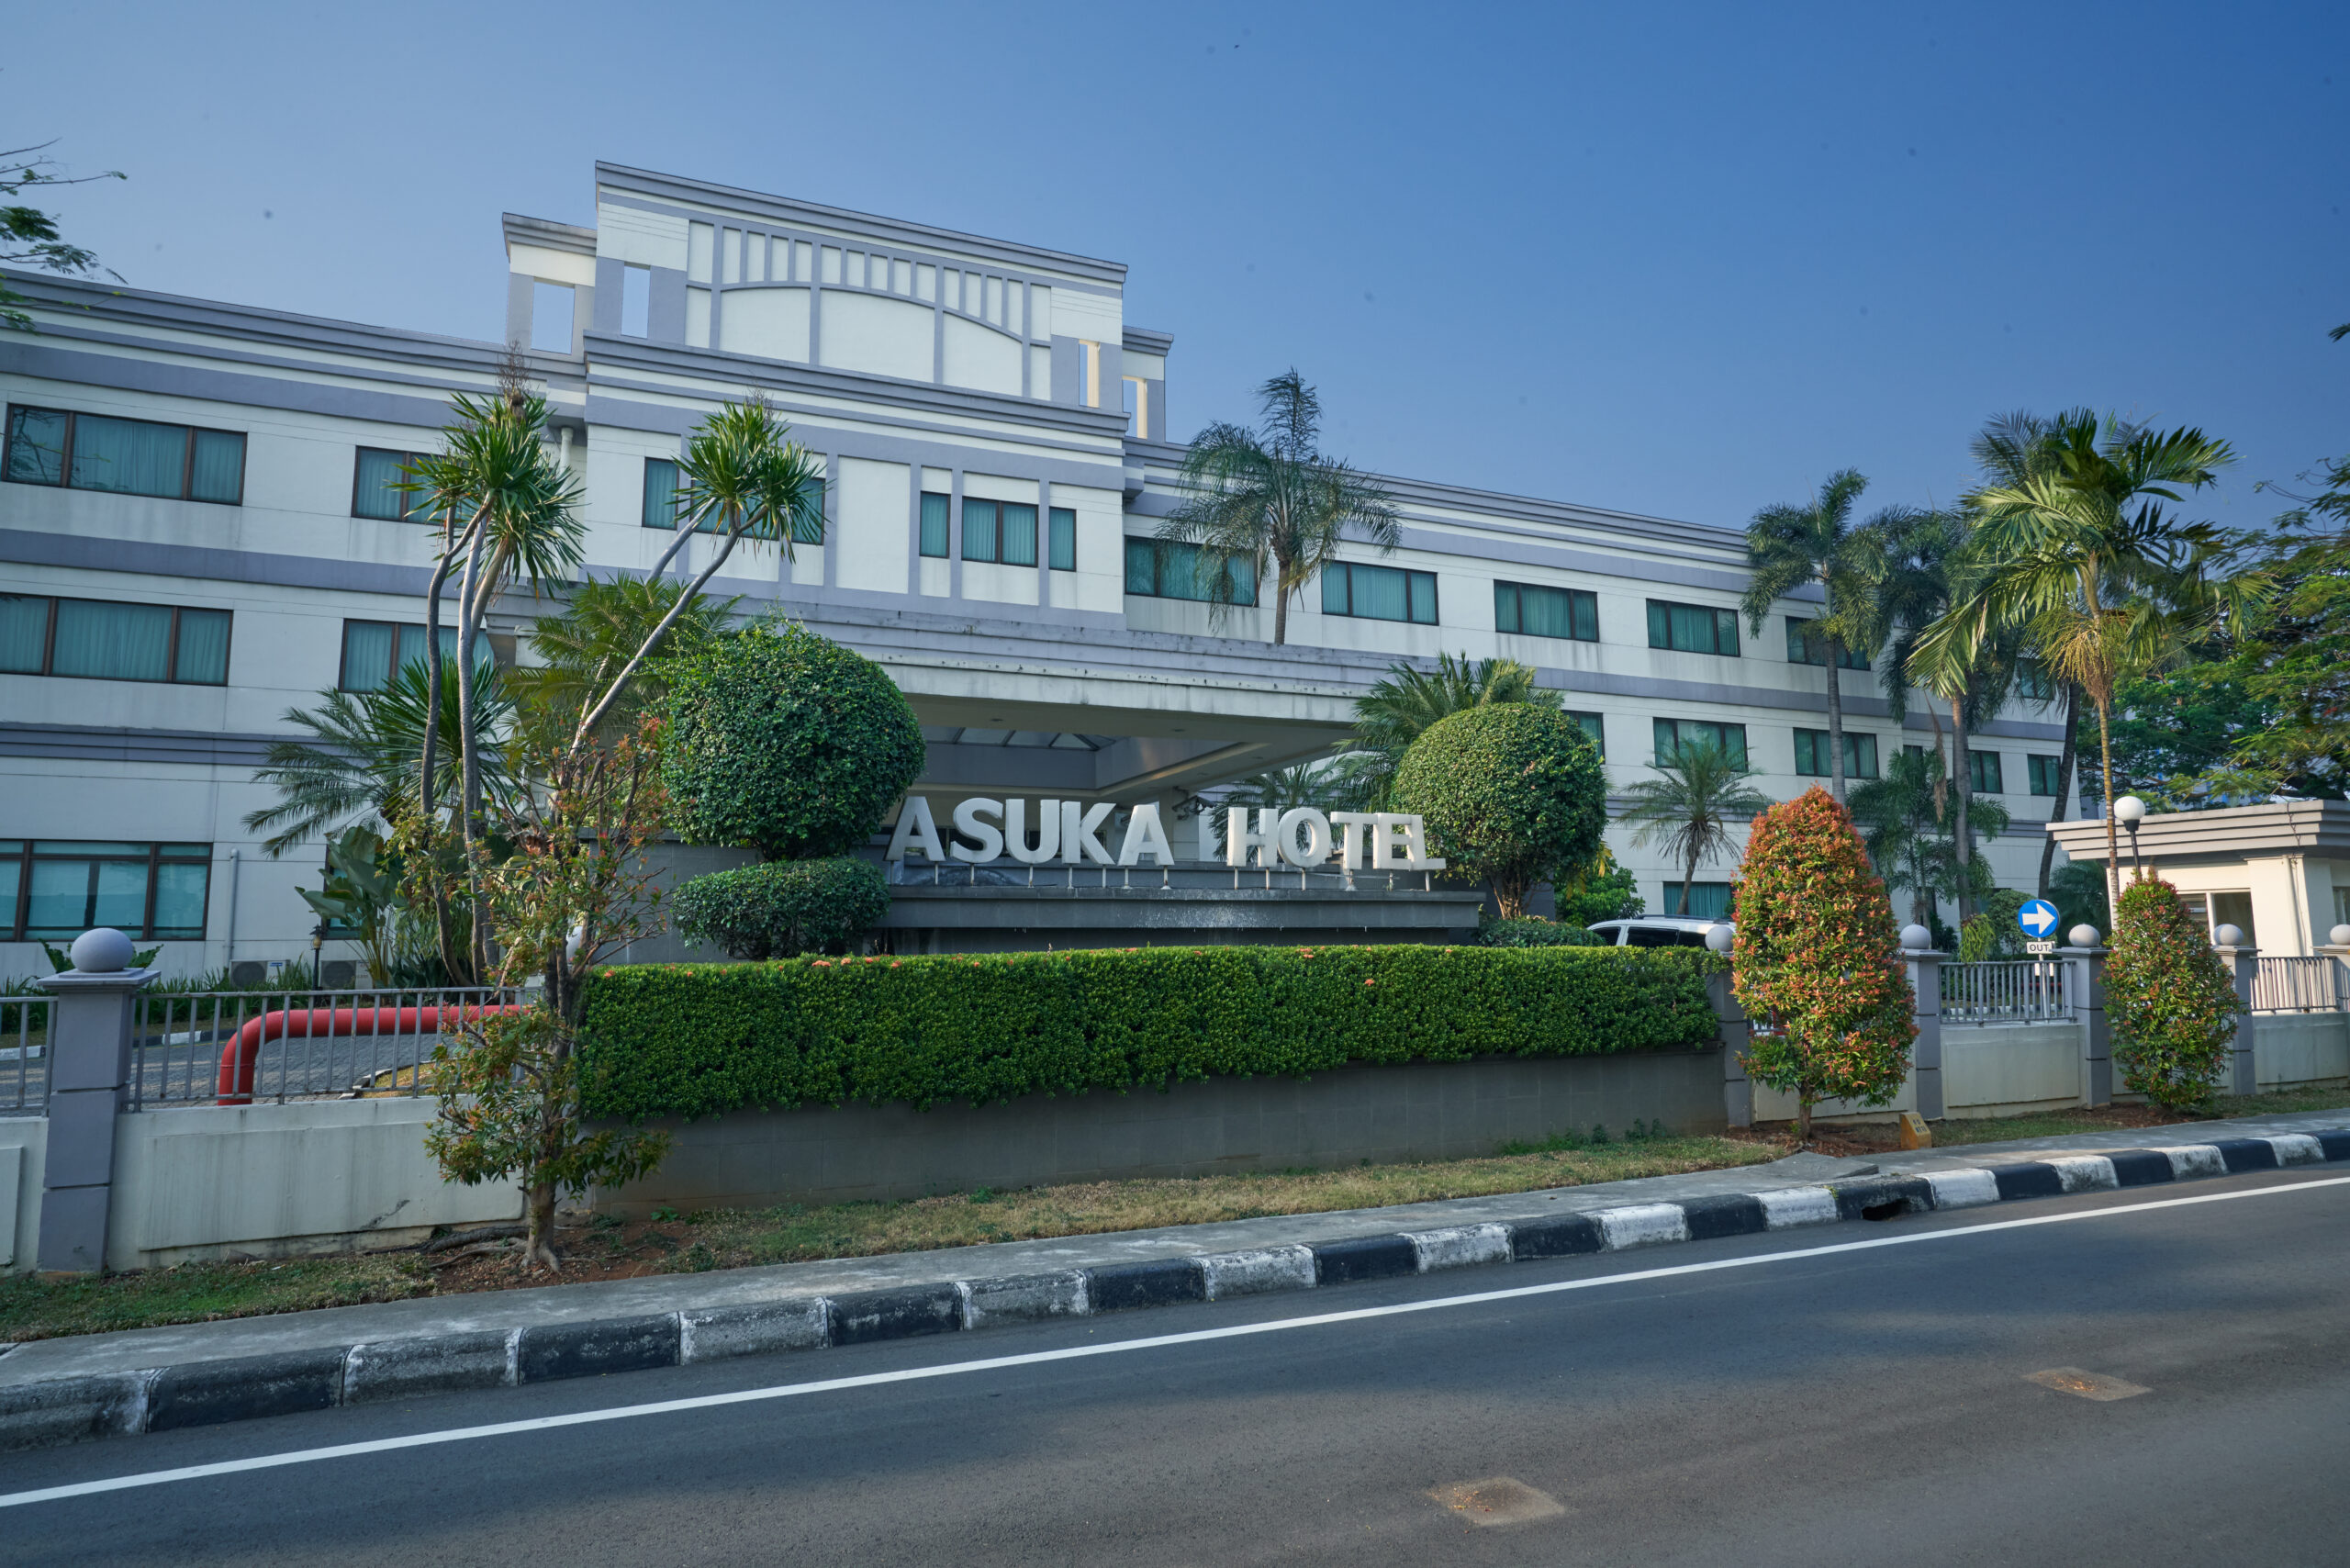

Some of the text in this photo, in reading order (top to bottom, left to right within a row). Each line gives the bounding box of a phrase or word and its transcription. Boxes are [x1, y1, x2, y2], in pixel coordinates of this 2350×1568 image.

[885, 796, 1447, 871] ASUKA HOTEL
[2030, 944, 2049, 952] OUT
